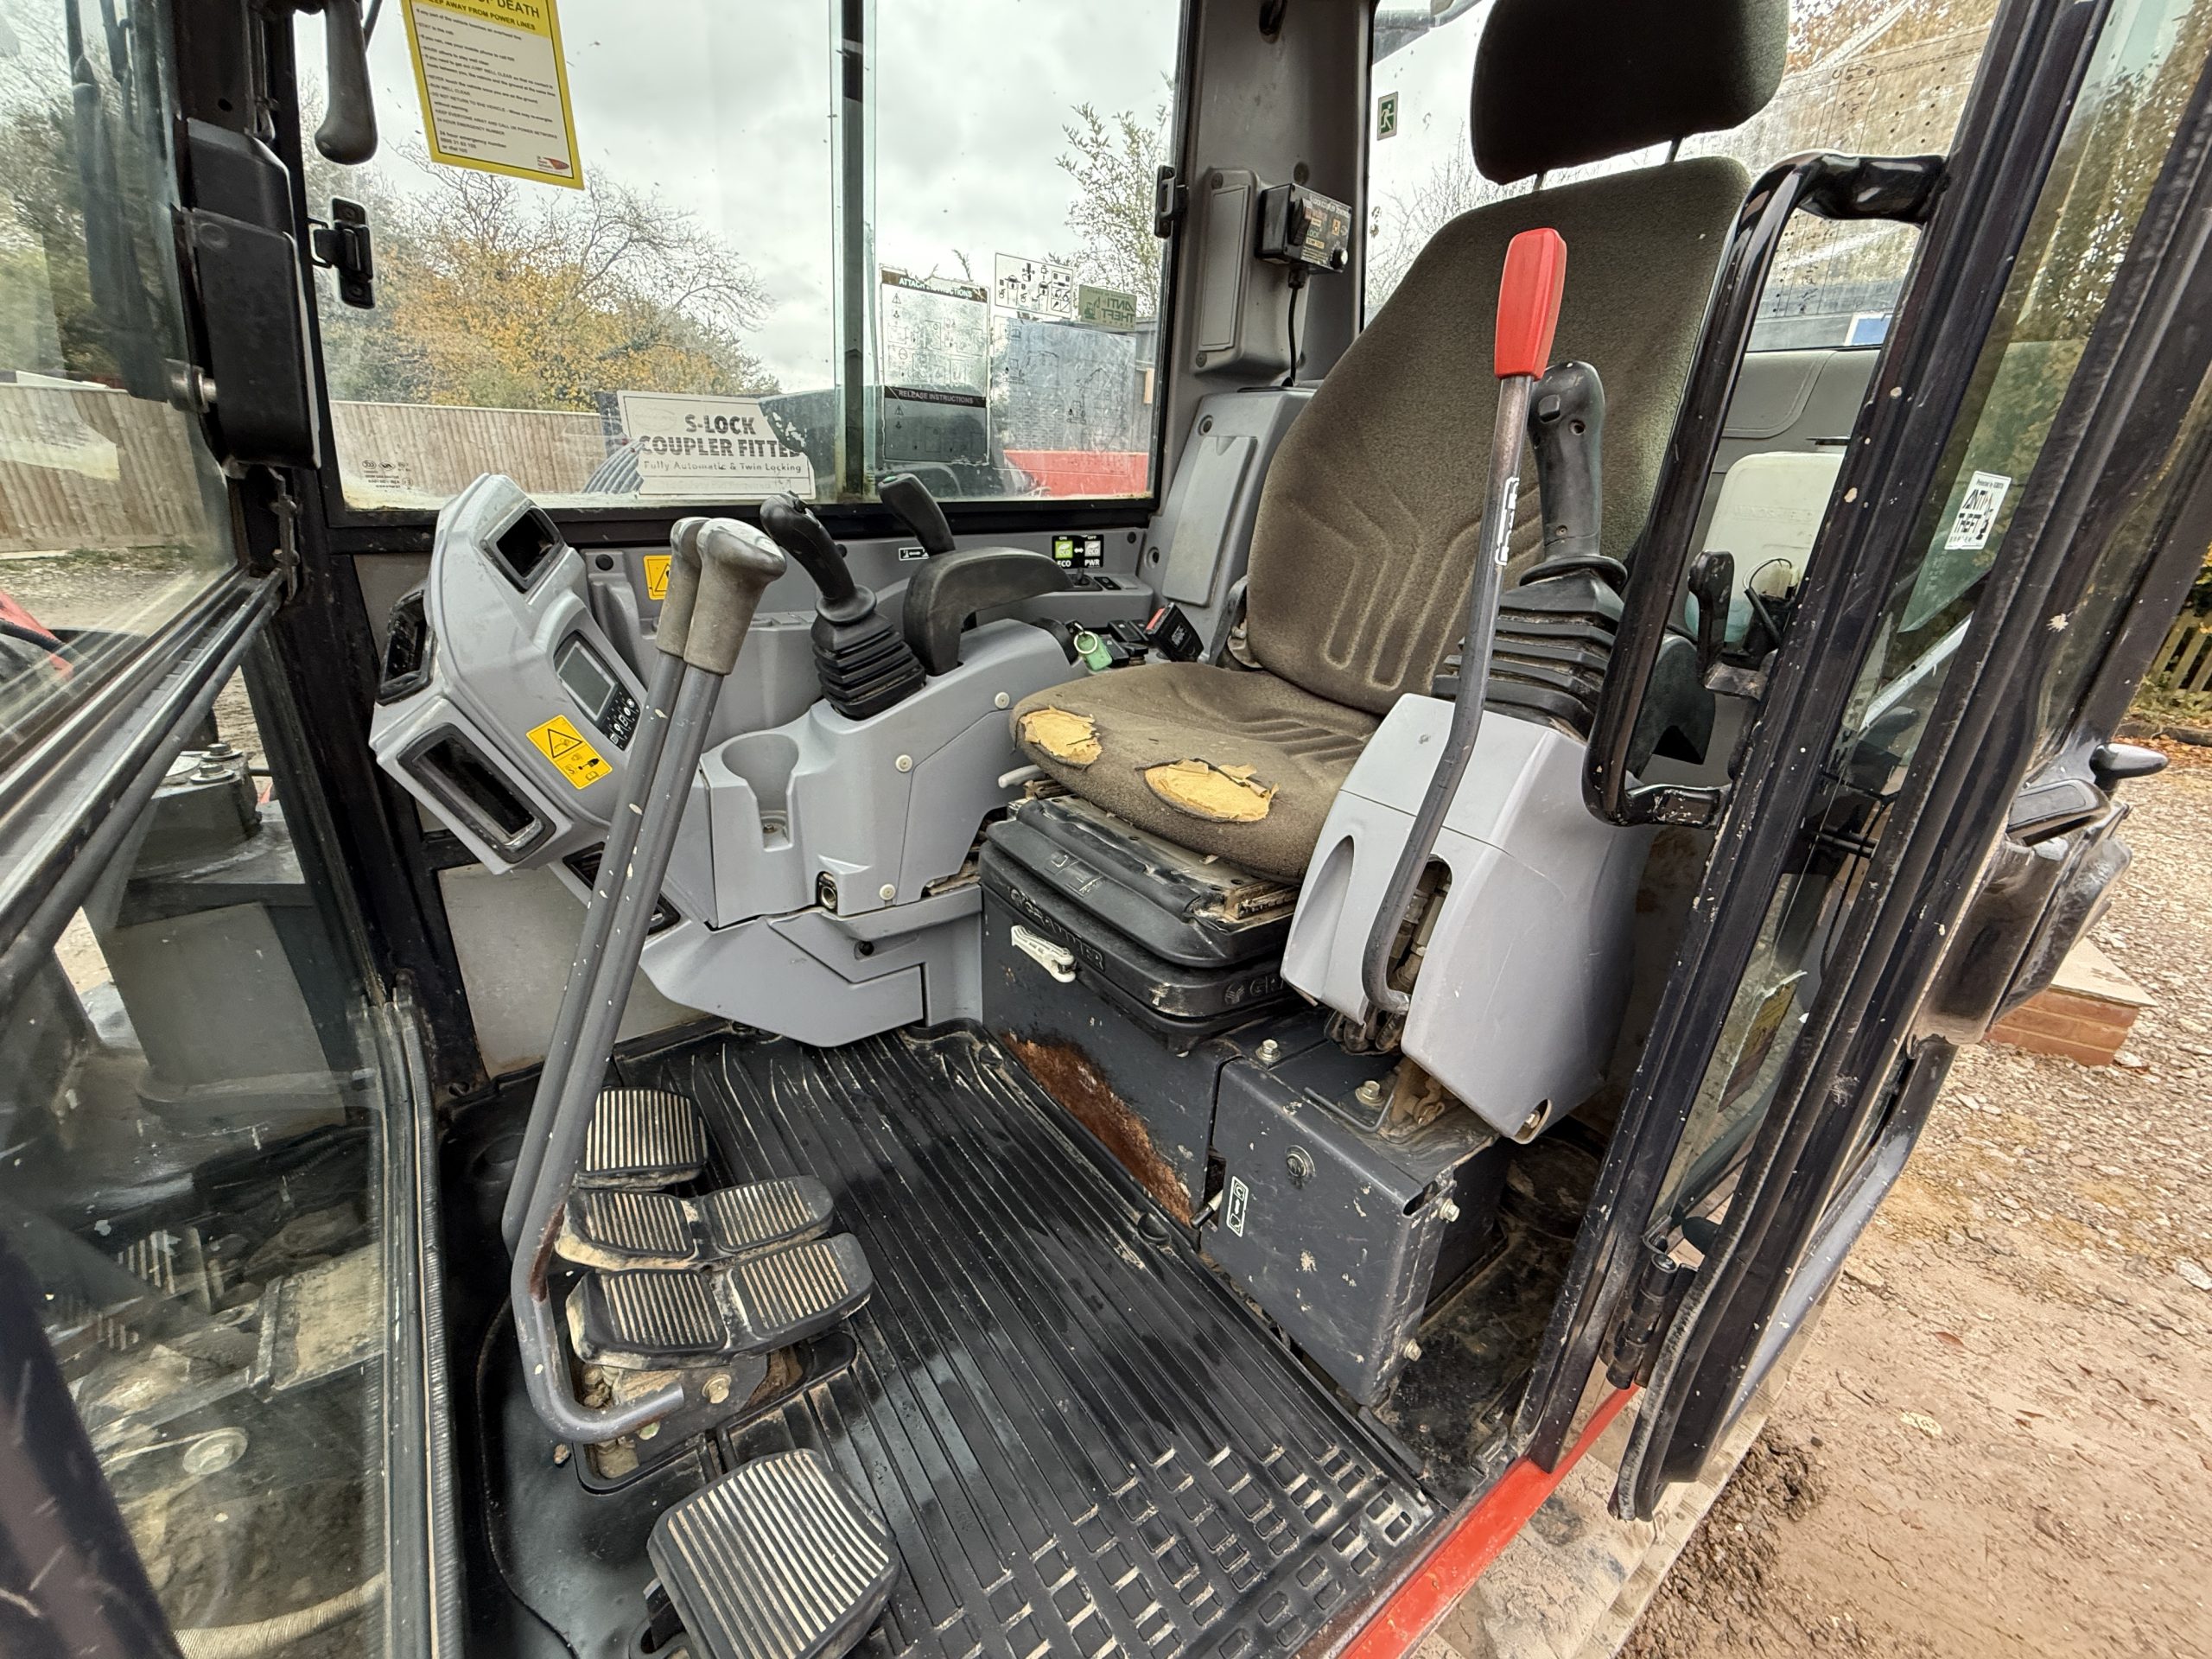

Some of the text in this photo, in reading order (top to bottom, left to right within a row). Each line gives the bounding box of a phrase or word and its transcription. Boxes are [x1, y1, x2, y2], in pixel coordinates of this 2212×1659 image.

[444, 0, 467, 11] AWAY
[467, 6, 488, 17] FROM
[489, 11, 515, 24] POWER
[516, 19, 536, 30] LINES
[498, 0, 540, 18] DEATH
[899, 390, 973, 404] RELEASE INSTRUCTIONS
[684, 414, 756, 435] S-LOCK
[639, 435, 734, 456] COUPLER
[644, 460, 670, 471] Fully
[673, 461, 726, 470] Automatic
[765, 463, 801, 473] Locking
